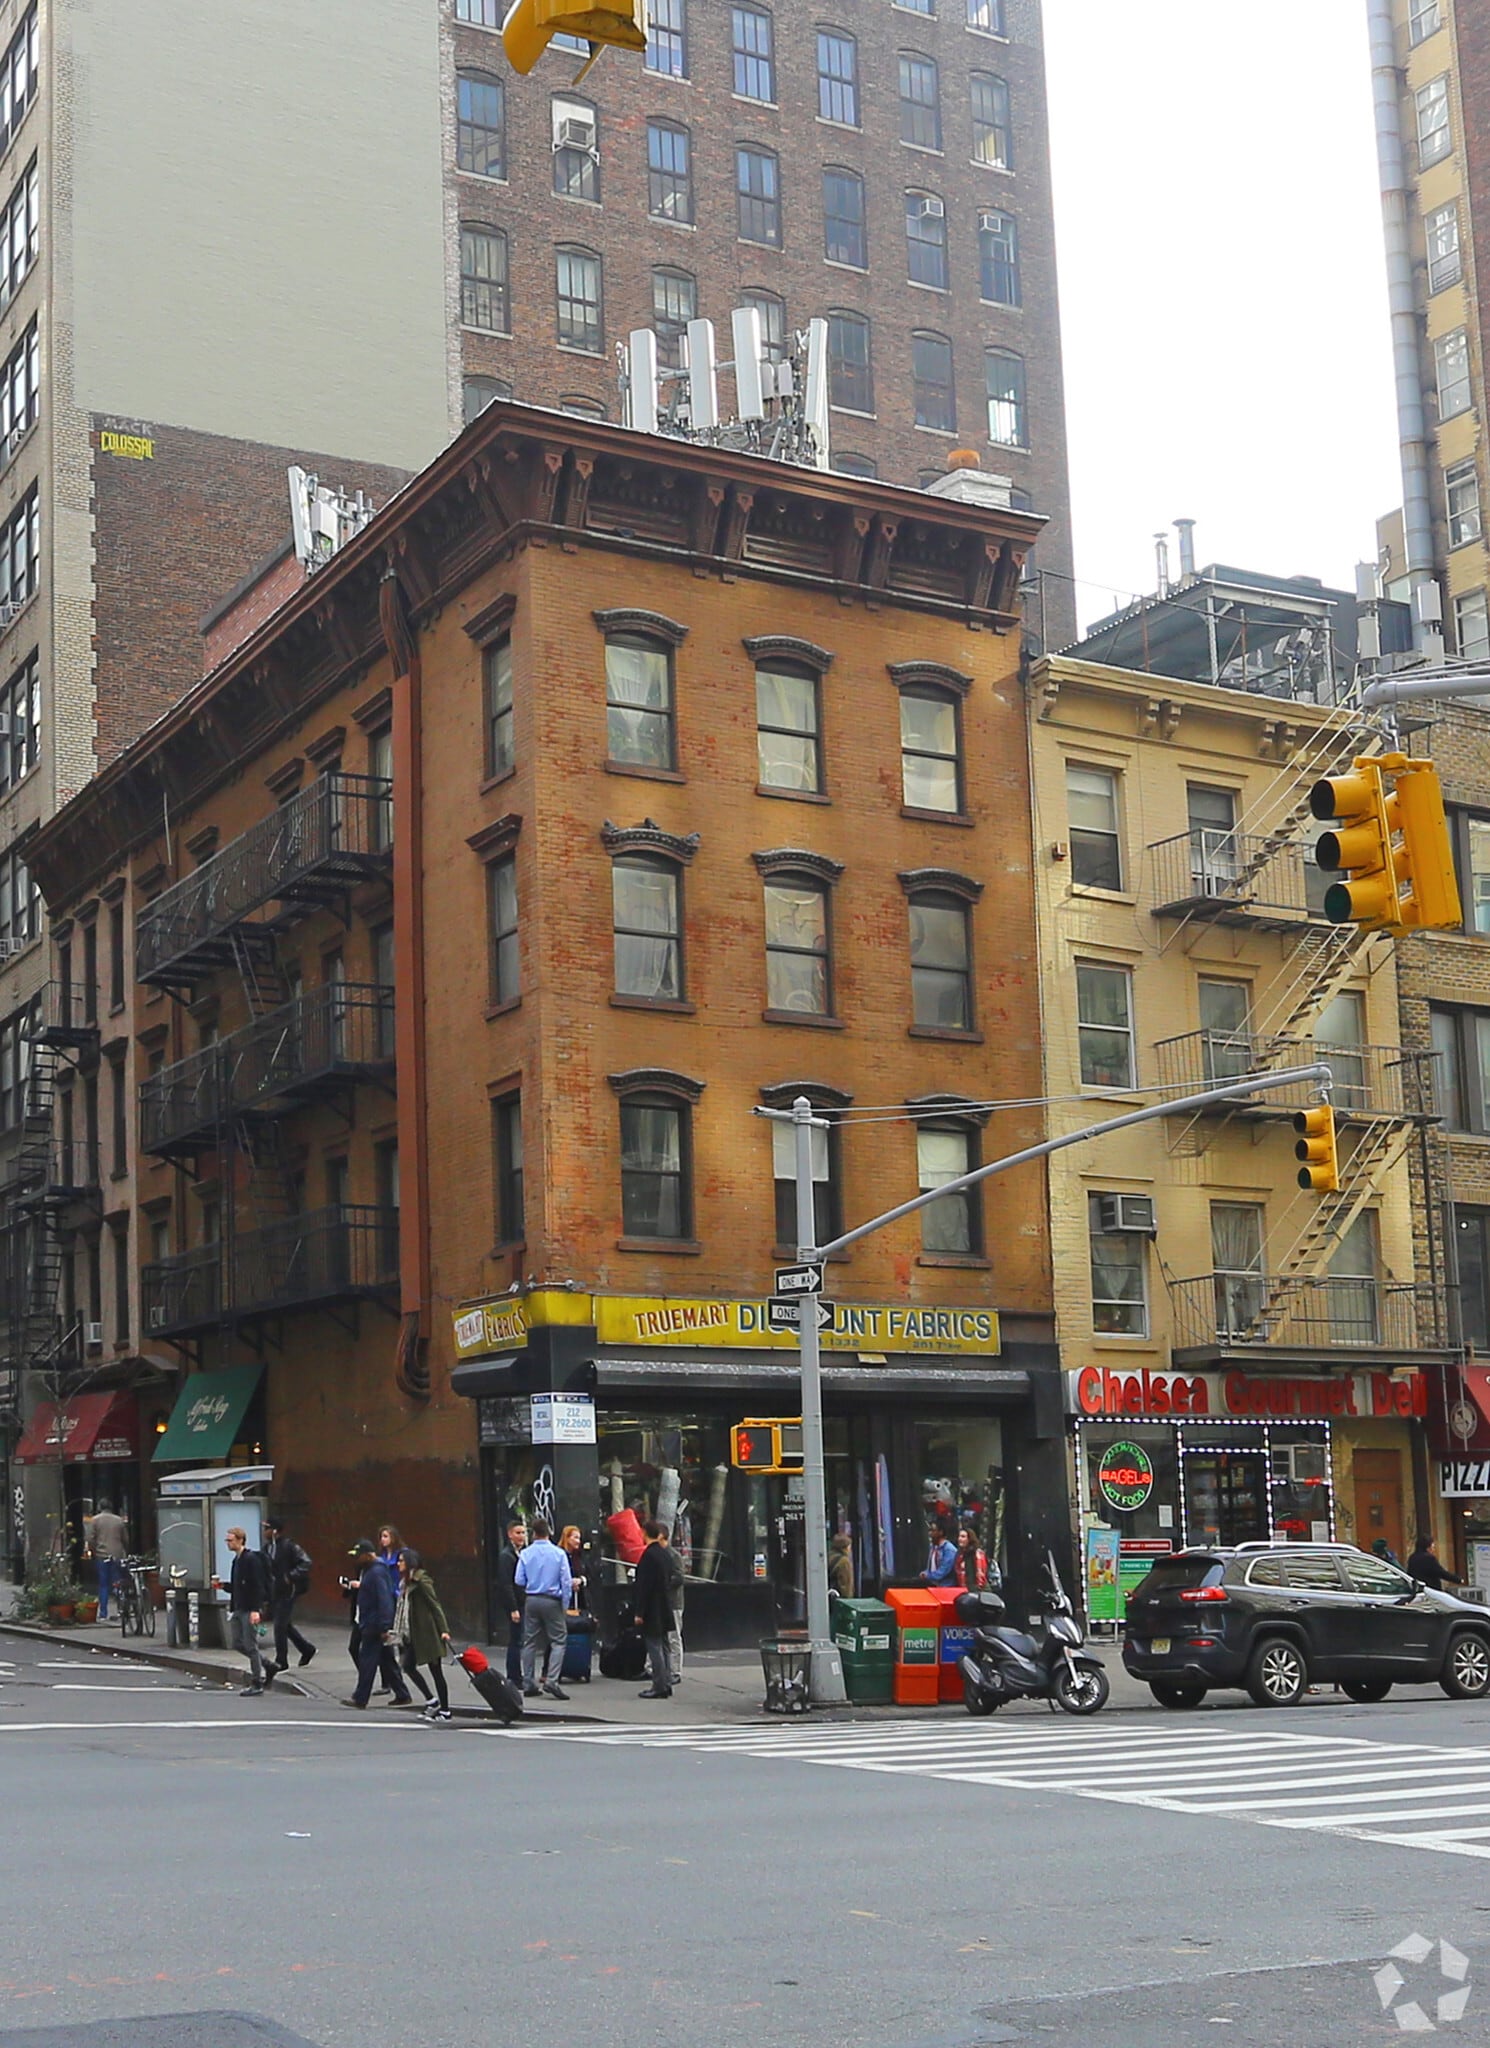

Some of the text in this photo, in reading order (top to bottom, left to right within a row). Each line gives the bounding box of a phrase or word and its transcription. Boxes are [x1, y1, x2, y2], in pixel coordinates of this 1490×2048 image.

[782, 1274, 815, 1288] ONE WAY
[777, 1307, 797, 1319] ONE
[484, 1305, 528, 1347] FABRICS
[634, 1303, 731, 1339] TRUEMART
[887, 1311, 991, 1343] FABRICS
[1077, 1366, 1428, 1417] Chelsea Gourmet Deli
[566, 1407, 581, 1418] 212
[1100, 1468, 1152, 1485] BAGELS
[944, 1627, 975, 1641] VOICE
[904, 1638, 935, 1649] metro
